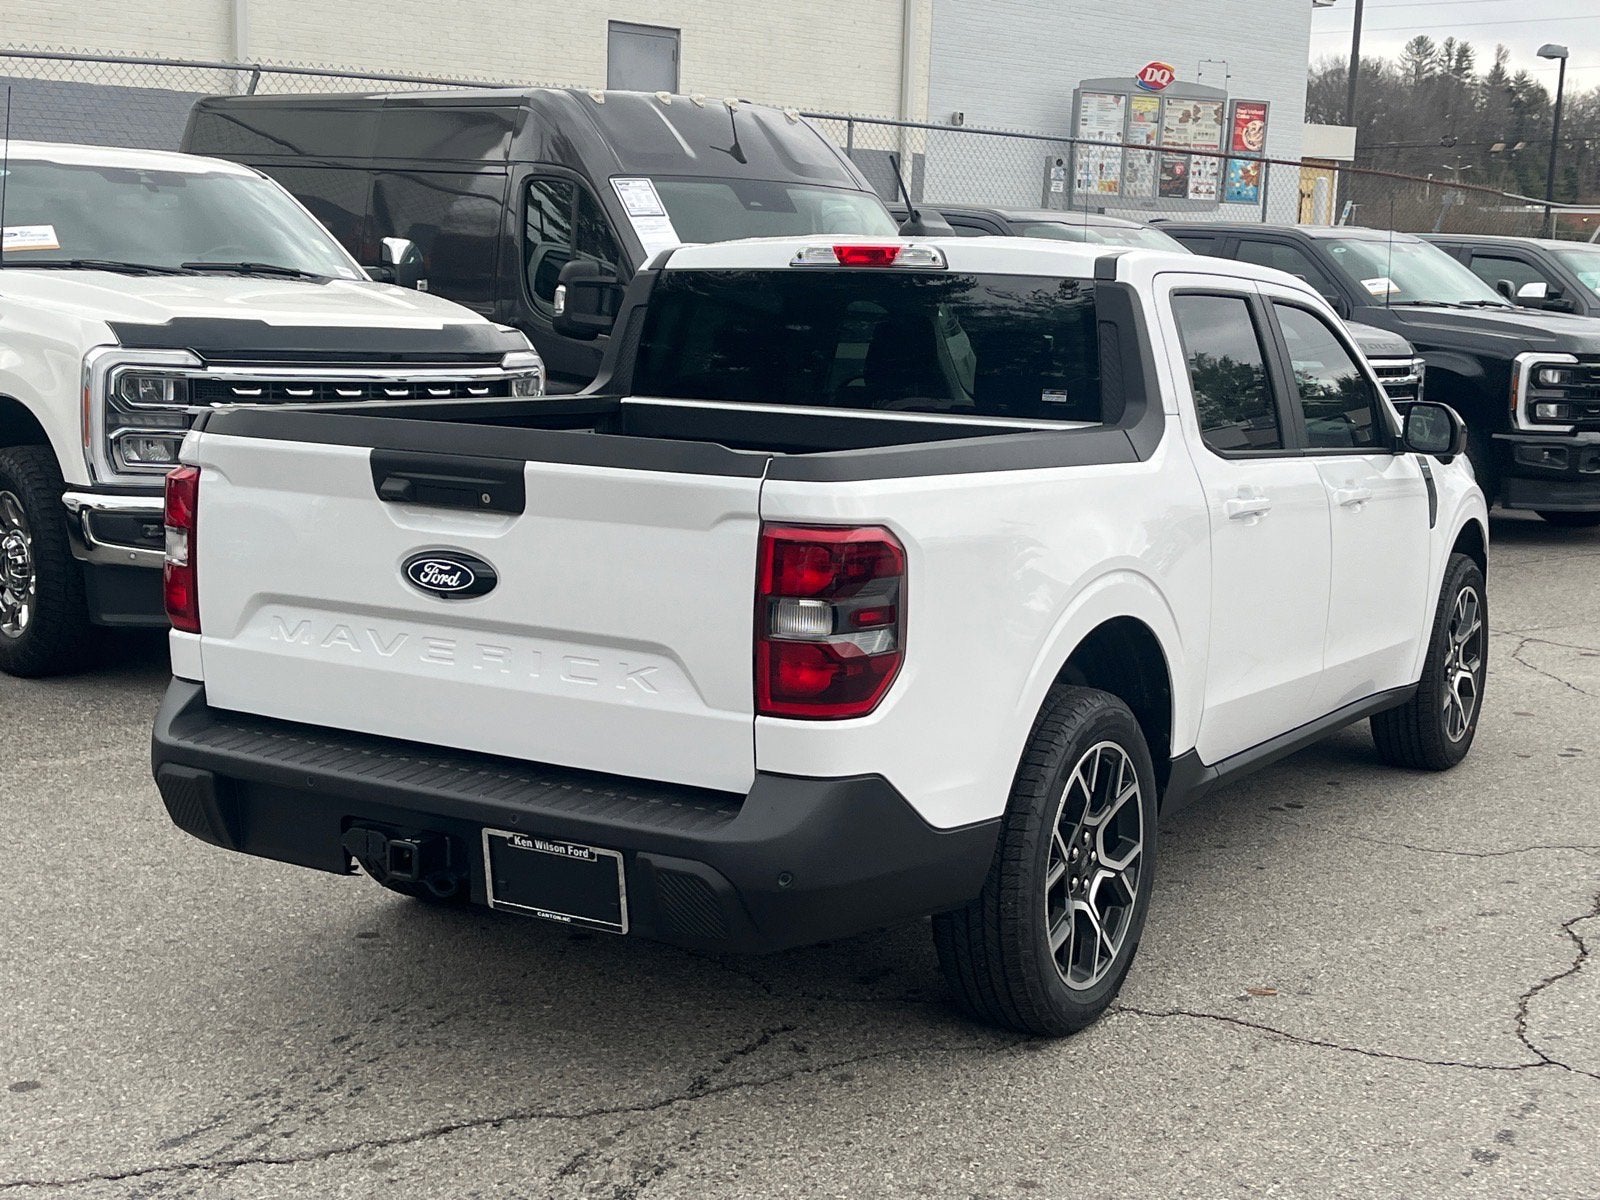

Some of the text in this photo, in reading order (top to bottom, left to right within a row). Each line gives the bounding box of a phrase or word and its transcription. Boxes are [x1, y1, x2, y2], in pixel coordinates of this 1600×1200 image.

[1144, 67, 1170, 86] DQ
[420, 562, 461, 586] Ford
[270, 614, 660, 695] MAVERICK
[514, 836, 589, 858] Ken Wilson Ford
